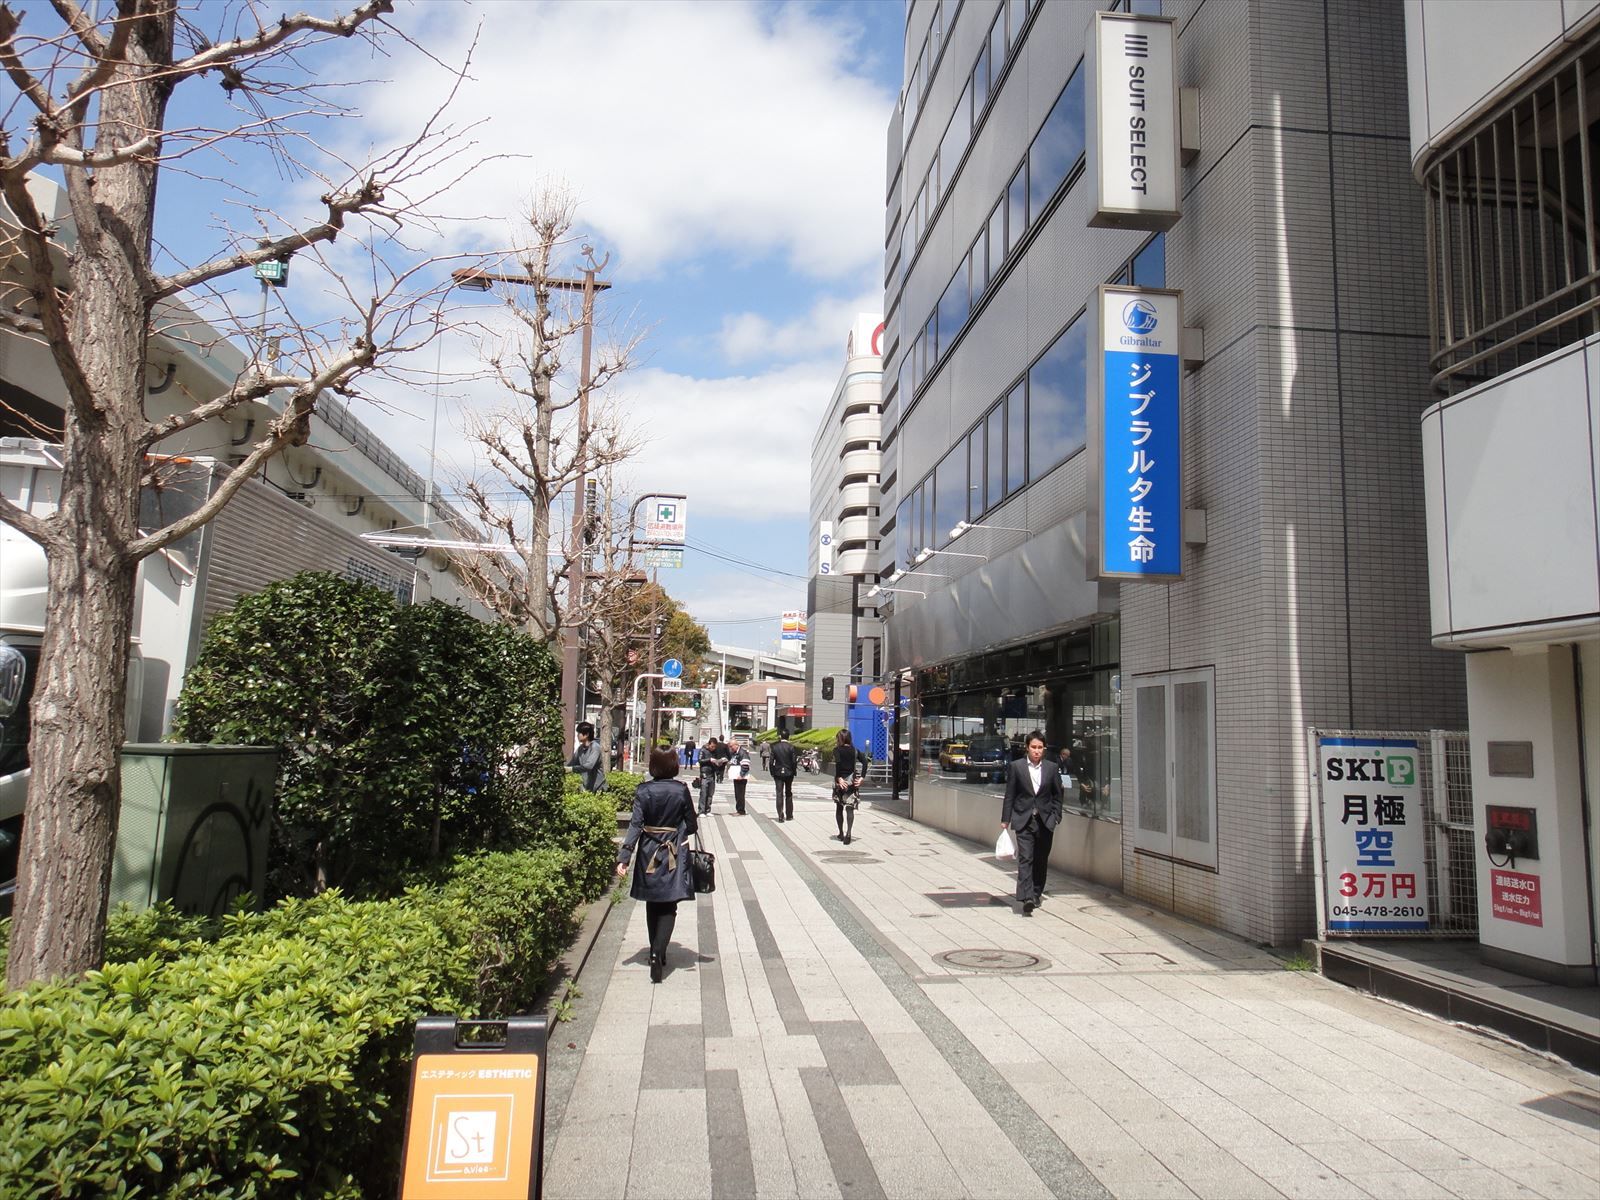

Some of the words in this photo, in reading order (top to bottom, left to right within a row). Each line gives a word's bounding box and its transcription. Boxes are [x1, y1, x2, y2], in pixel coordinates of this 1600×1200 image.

[1129, 65, 1145, 111] SUIT
[1129, 116, 1147, 195] SELECT
[1120, 335, 1162, 348] Gibraltar
[1128, 362, 1156, 563] ジブラルタ生命
[1341, 794, 1406, 826] 月極
[1355, 827, 1395, 866] 空
[1339, 872, 1416, 899] 3万円
[1333, 905, 1424, 917] 045-478-2610
[420, 1069, 475, 1079] エステティック
[478, 1069, 532, 1079] ESTHETIC
